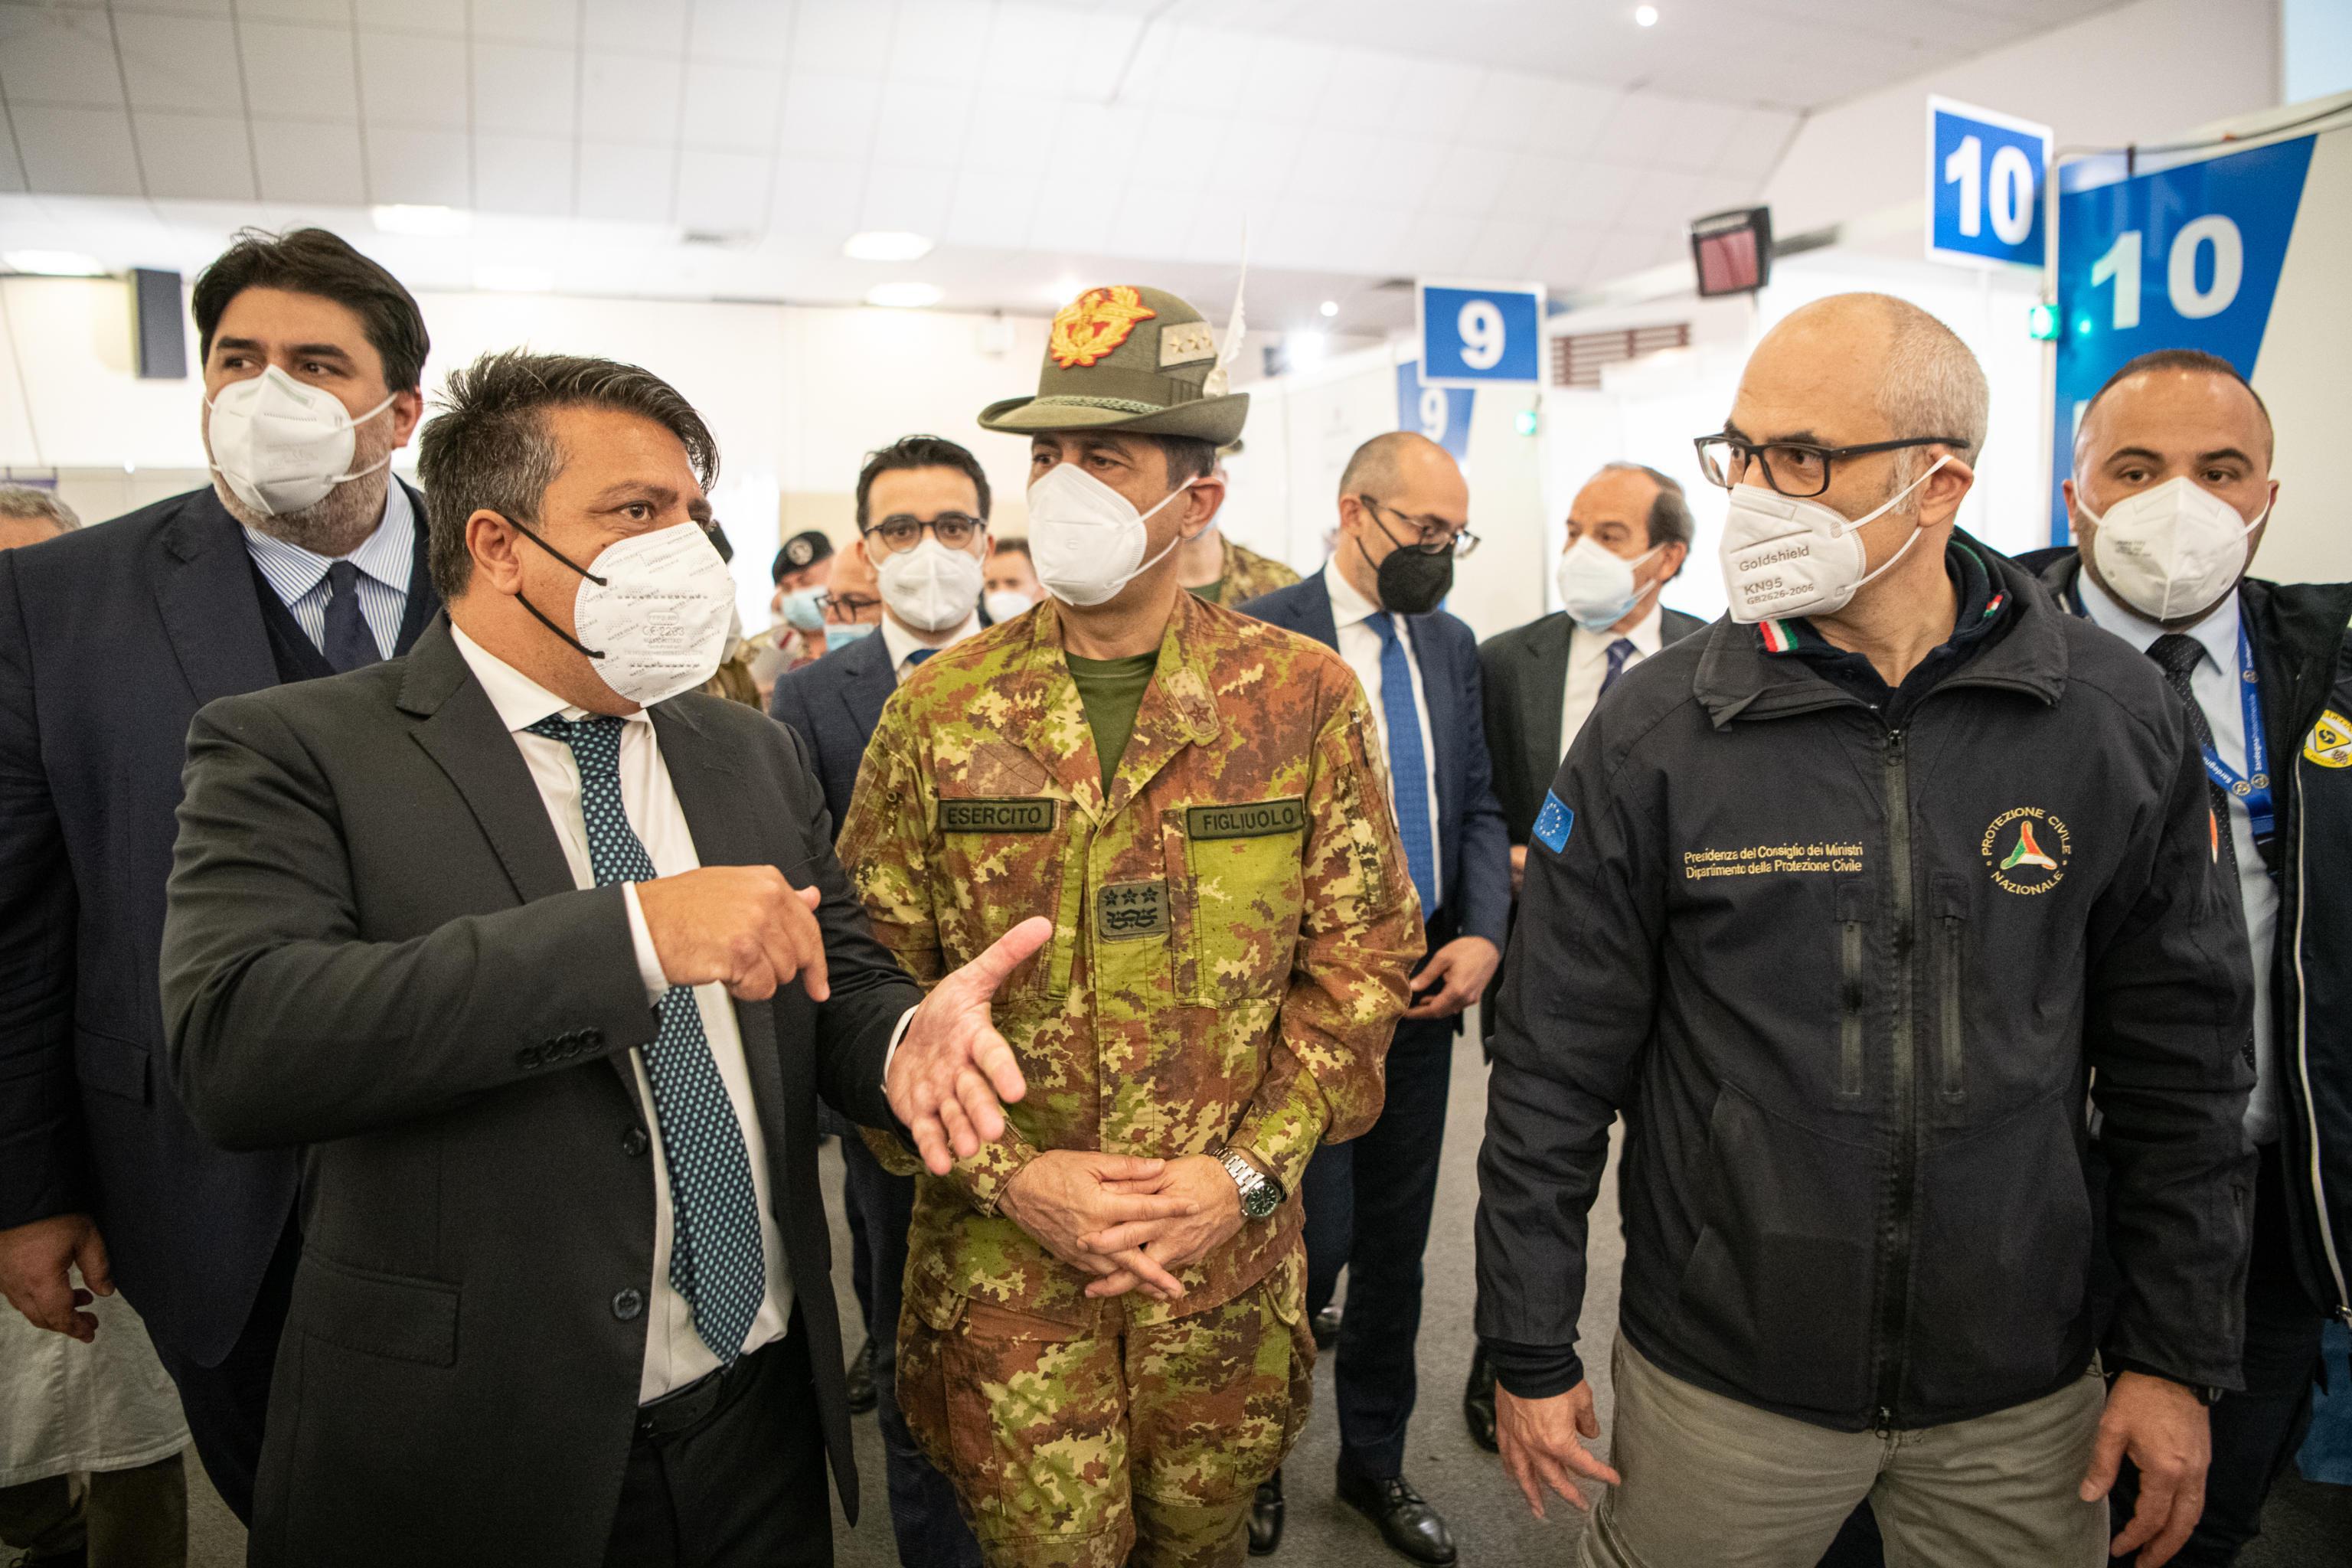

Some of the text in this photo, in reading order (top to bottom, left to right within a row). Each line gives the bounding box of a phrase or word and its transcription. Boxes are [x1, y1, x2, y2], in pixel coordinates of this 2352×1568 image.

[1945, 135, 2034, 246] 10
[2090, 214, 2244, 331] 10
[1457, 299, 1506, 370] 9
[1419, 387, 1449, 445] 9
[1739, 545, 1810, 573] Goldshield
[1743, 577, 1783, 596] KN95
[1746, 584, 1815, 606] GB2626-2006
[948, 806, 1042, 825] ESERCITO
[1203, 807, 1294, 831] FIGLIUOLO
[1981, 807, 2072, 856] PROTEZIONE CIVILE
[1684, 841, 1863, 864] Presidenza del Consiglio dei Ministri
[1686, 858, 1862, 880] Dipartimento della Protezione Civile
[1991, 871, 2064, 895] NAZIONALE
